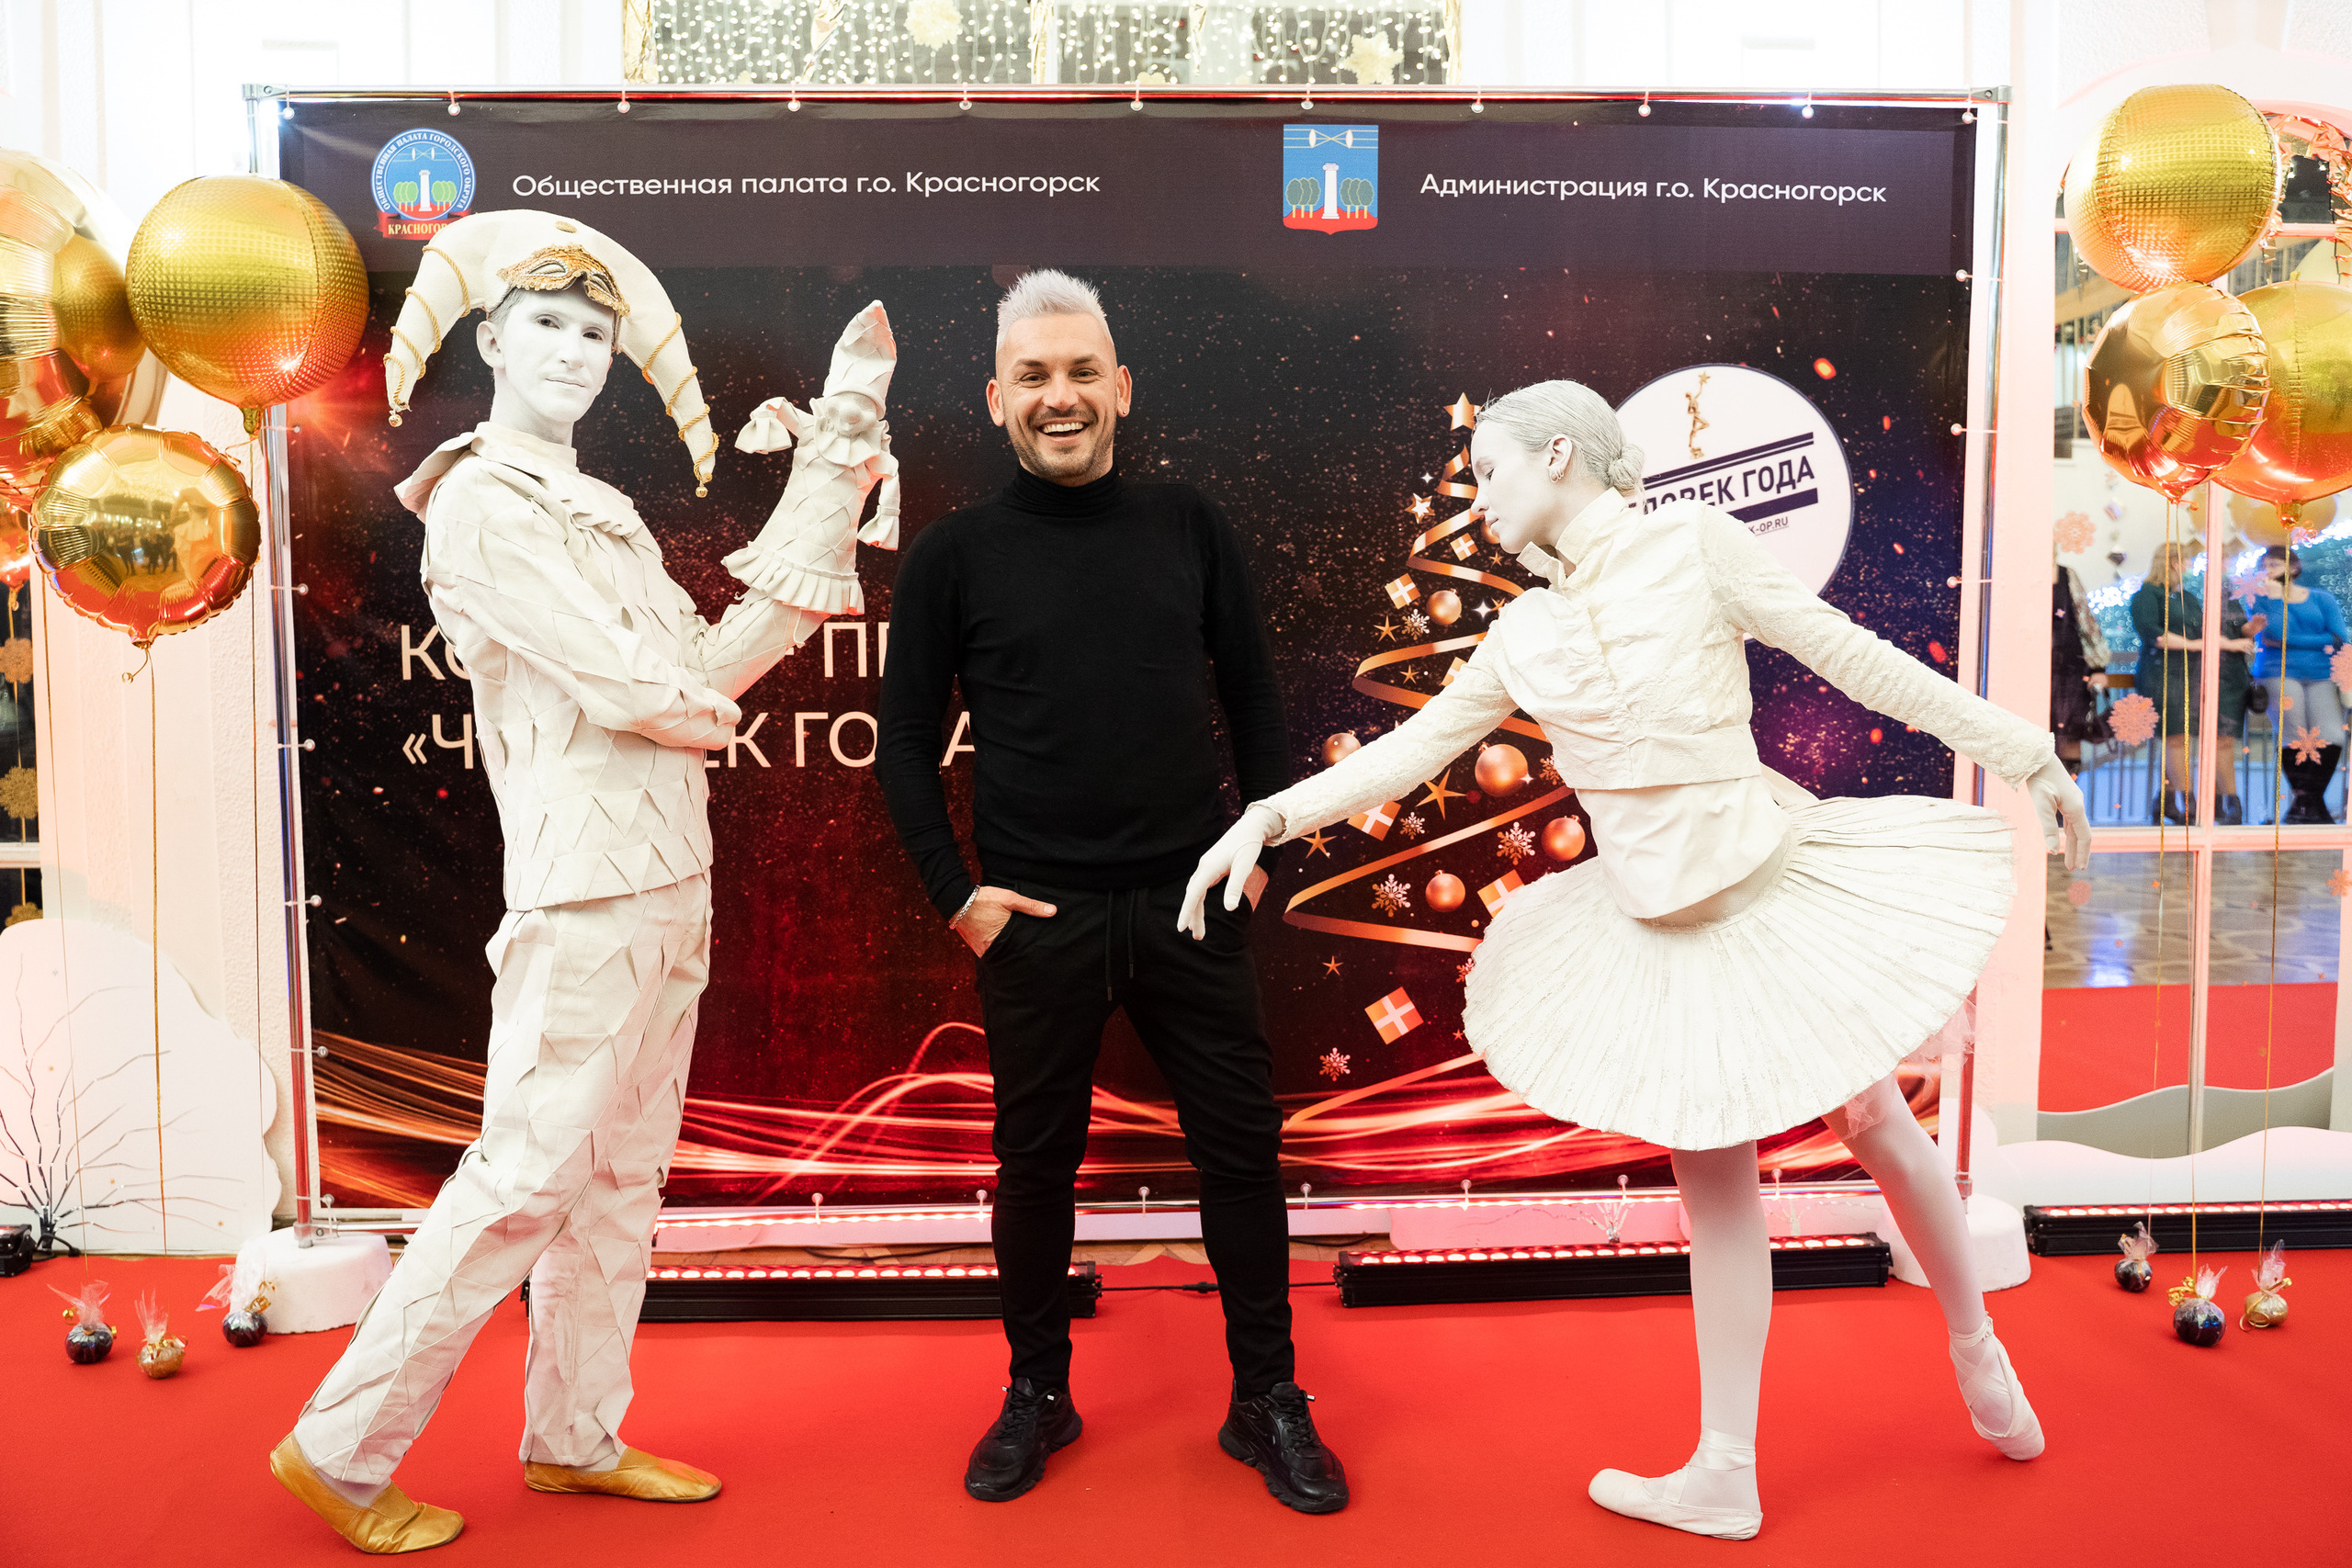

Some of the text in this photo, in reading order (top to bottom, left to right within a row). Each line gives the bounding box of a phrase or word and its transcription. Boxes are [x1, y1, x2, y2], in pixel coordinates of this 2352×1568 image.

[396, 132, 428, 148] ПАЛАТА
[429, 133, 471, 176] ГОРОДСКОГО
[457, 177, 472, 209] ОКРУГА
[512, 172, 1101, 198] Общественная палата г.о. Красногорск
[1419, 174, 1887, 207] Администрация г.о. Красногорск
[1742, 455, 1815, 498] ГОДА
